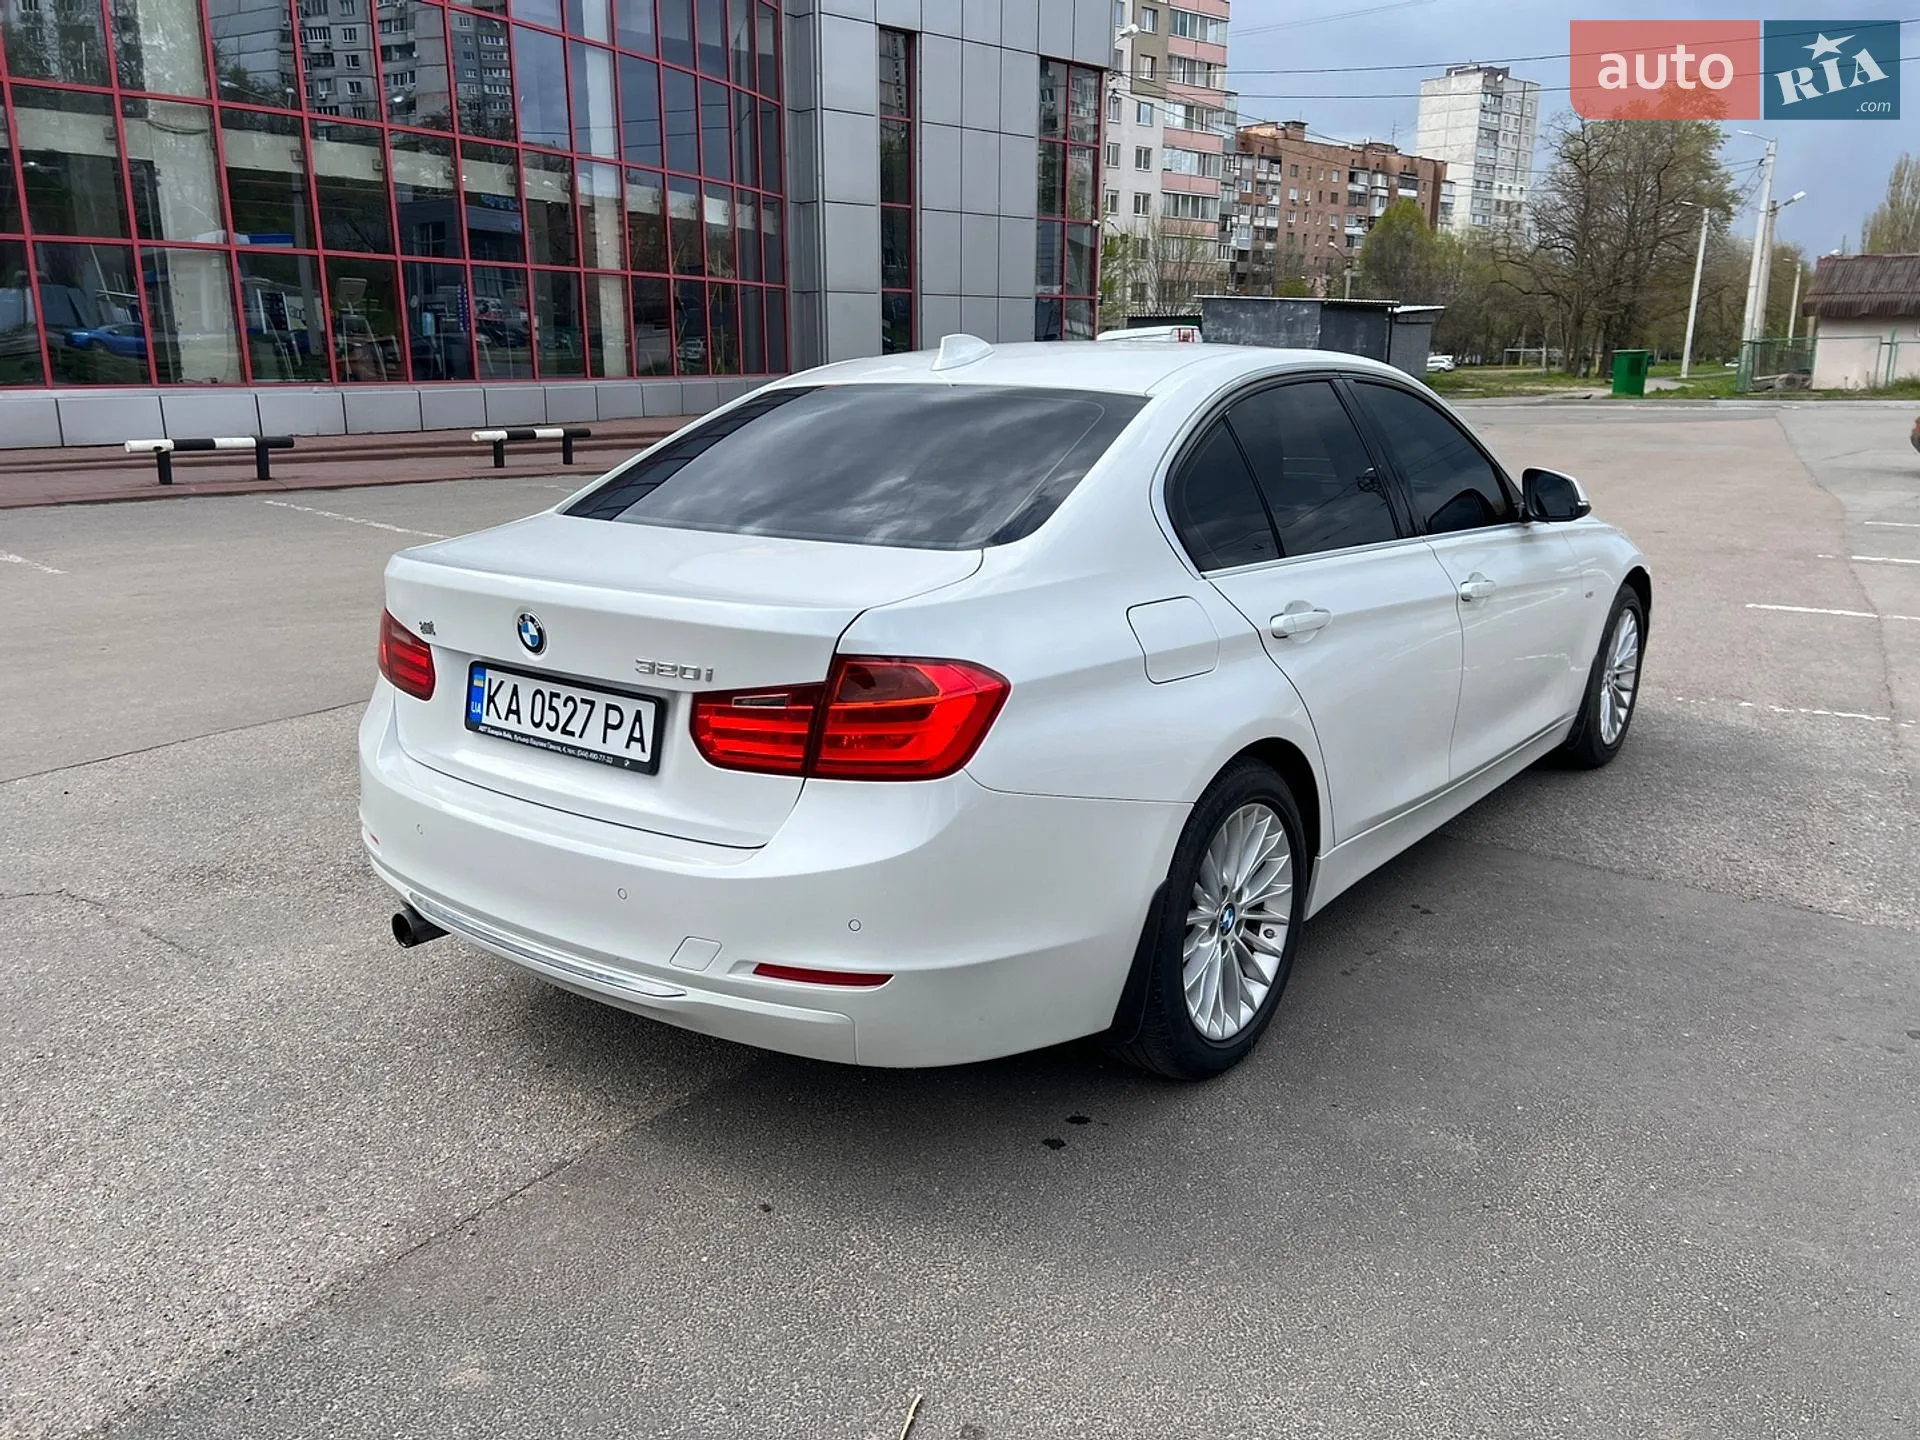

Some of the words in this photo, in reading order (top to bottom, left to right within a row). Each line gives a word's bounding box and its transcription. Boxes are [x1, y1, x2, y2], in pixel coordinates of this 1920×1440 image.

[635, 658, 713, 682] 320i
[486, 677, 522, 725] KA
[530, 688, 596, 739] 0527
[602, 703, 646, 753] PA
